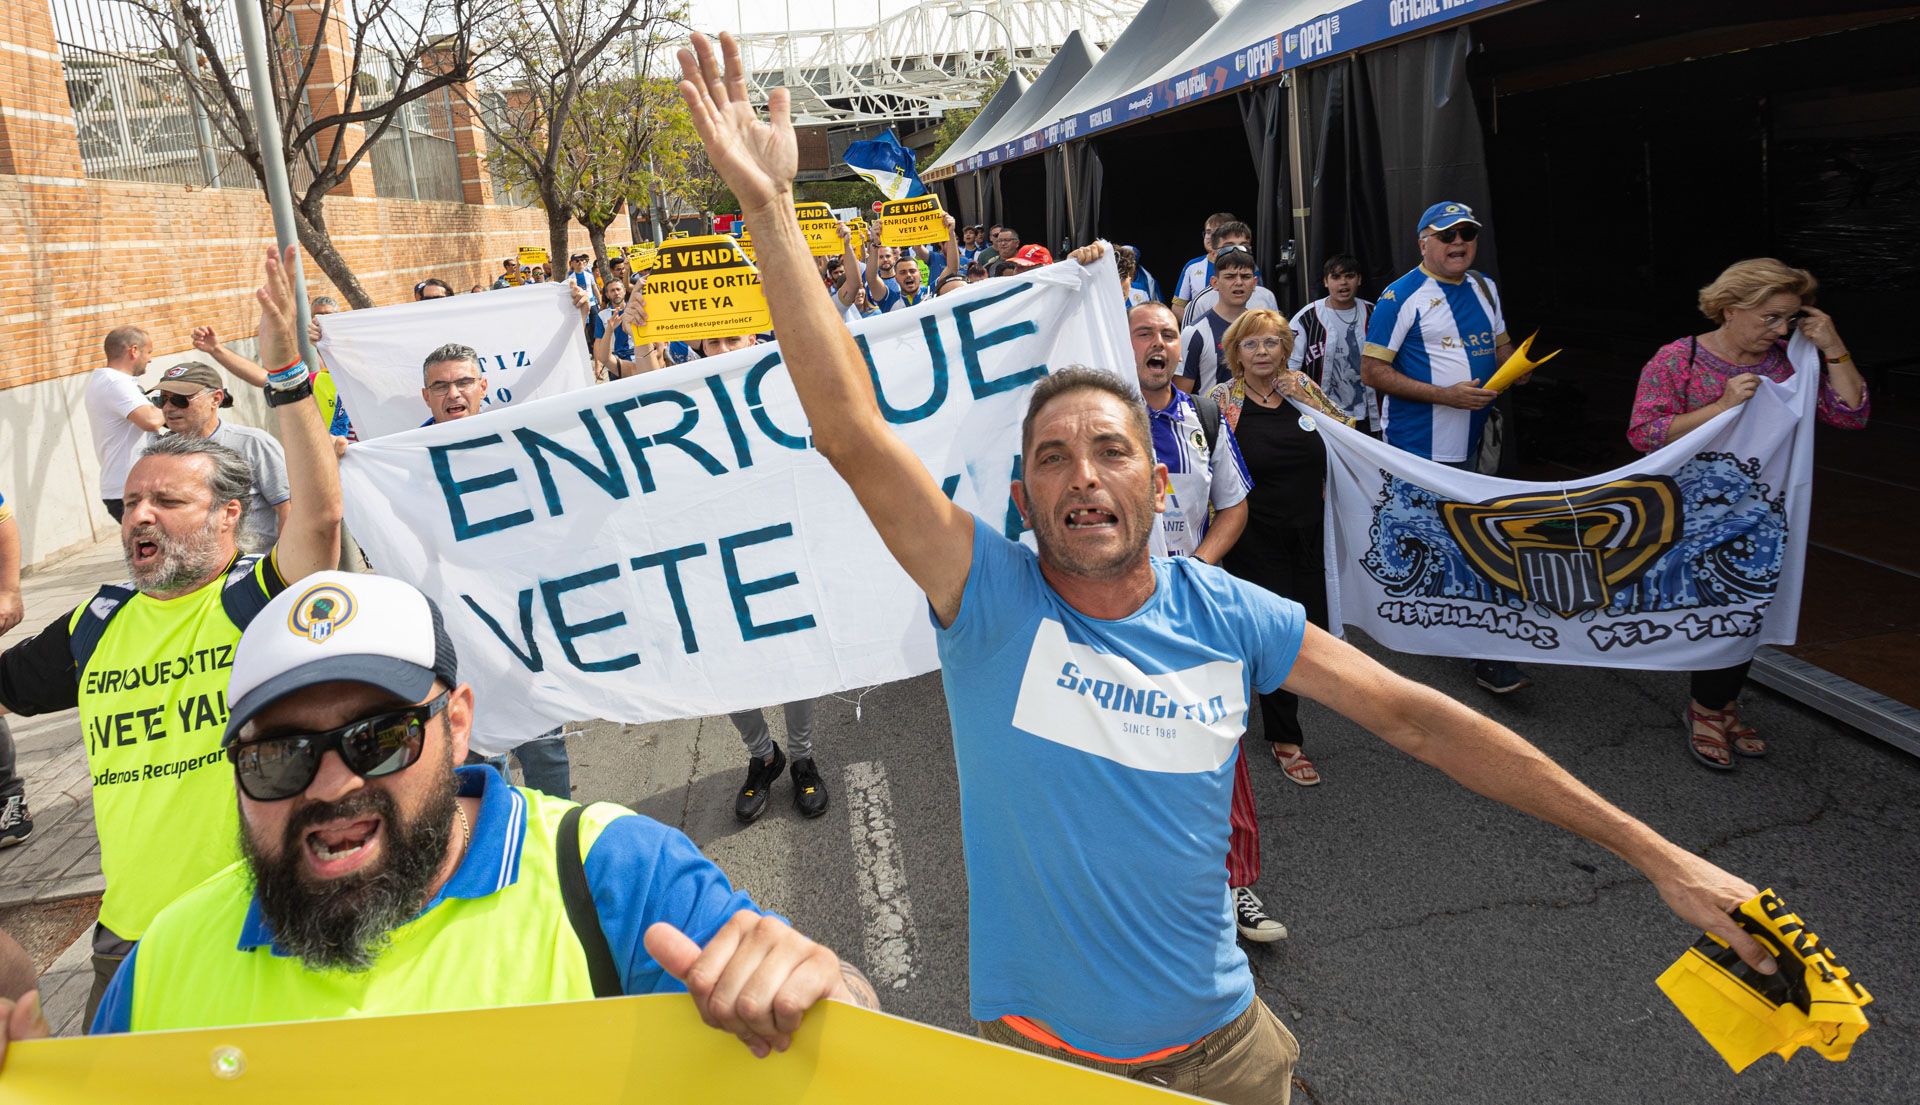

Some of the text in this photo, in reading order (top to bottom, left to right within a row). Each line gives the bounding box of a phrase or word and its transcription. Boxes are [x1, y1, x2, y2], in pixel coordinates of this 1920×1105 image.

[1300, 18, 1332, 60] OPEN
[1246, 41, 1273, 78] OPEN
[883, 212, 942, 226] ENRIQUE ORTIZ
[889, 201, 934, 215] SE VENDE
[811, 222, 837, 231] ORTIZ
[898, 224, 929, 235] VETE YA
[652, 253, 673, 270] SE
[676, 247, 743, 268] VENDE
[641, 273, 761, 296] ENRIQUE ORTIZ
[669, 295, 734, 313] VETE YA
[656, 316, 753, 331] #PodemosRecuperarloHCF
[1523, 551, 1598, 613] HDT
[461, 522, 817, 673] VETE
[1587, 613, 1673, 652] DEL
[86, 644, 233, 695] ENRIQUE ORTIZ
[178, 690, 227, 734] YA!
[1122, 722, 1151, 736] SINCE
